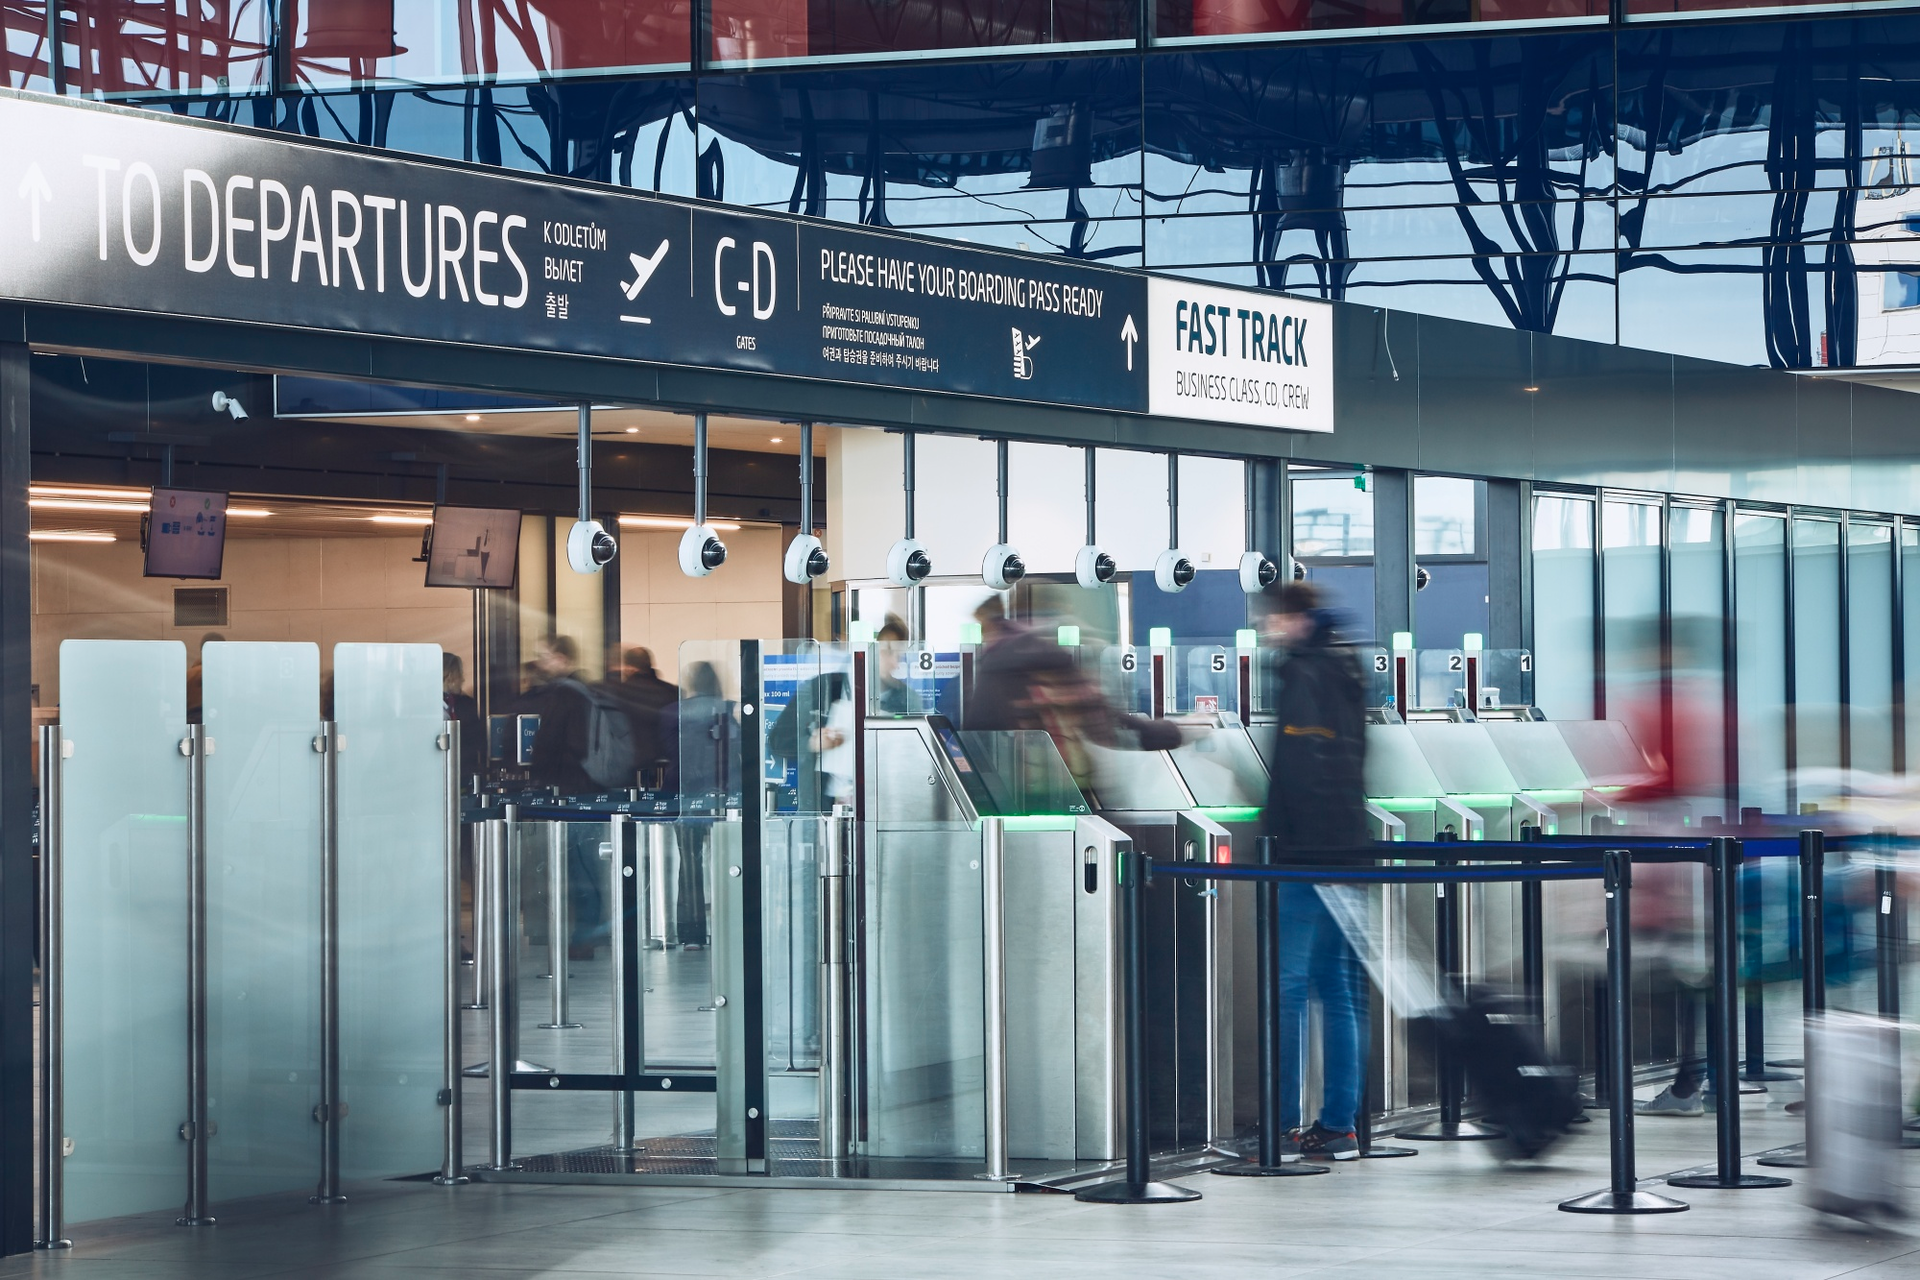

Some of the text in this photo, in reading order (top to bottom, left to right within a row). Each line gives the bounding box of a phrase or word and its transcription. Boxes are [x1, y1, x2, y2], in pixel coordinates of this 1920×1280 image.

[83, 155, 529, 309] TO DEPARTURES
[543, 221, 606, 251] K ODLETŮM
[544, 256, 584, 283] ВЫЛЕТ
[715, 236, 776, 320] C-D
[821, 248, 1103, 318] PLEASE HAVE YOUR BOARDING PASS READY
[545, 292, 569, 319] 출발
[822, 303, 920, 330] PŘIPRAVTE SI PALUBNÍ VSTUPENKU
[736, 335, 756, 350] GATES
[822, 325, 925, 350] ПРИГОТОВЬТЕ ПОСАДОЧНЫЙ ТАЛОН
[1176, 300, 1308, 367] FAST TRACK
[822, 346, 940, 373] 여권과 탑승권을 준비하여 주시기 바랍니다
[1176, 370, 1310, 410] BUSINESS CLASS, CD, CREW
[920, 652, 933, 670] 8
[1121, 654, 1135, 671] 6
[1212, 655, 1225, 671] 5
[1375, 656, 1387, 671] 3
[1450, 656, 1462, 670] 2
[1522, 656, 1531, 670] 1
[764, 718, 777, 730] Fas
